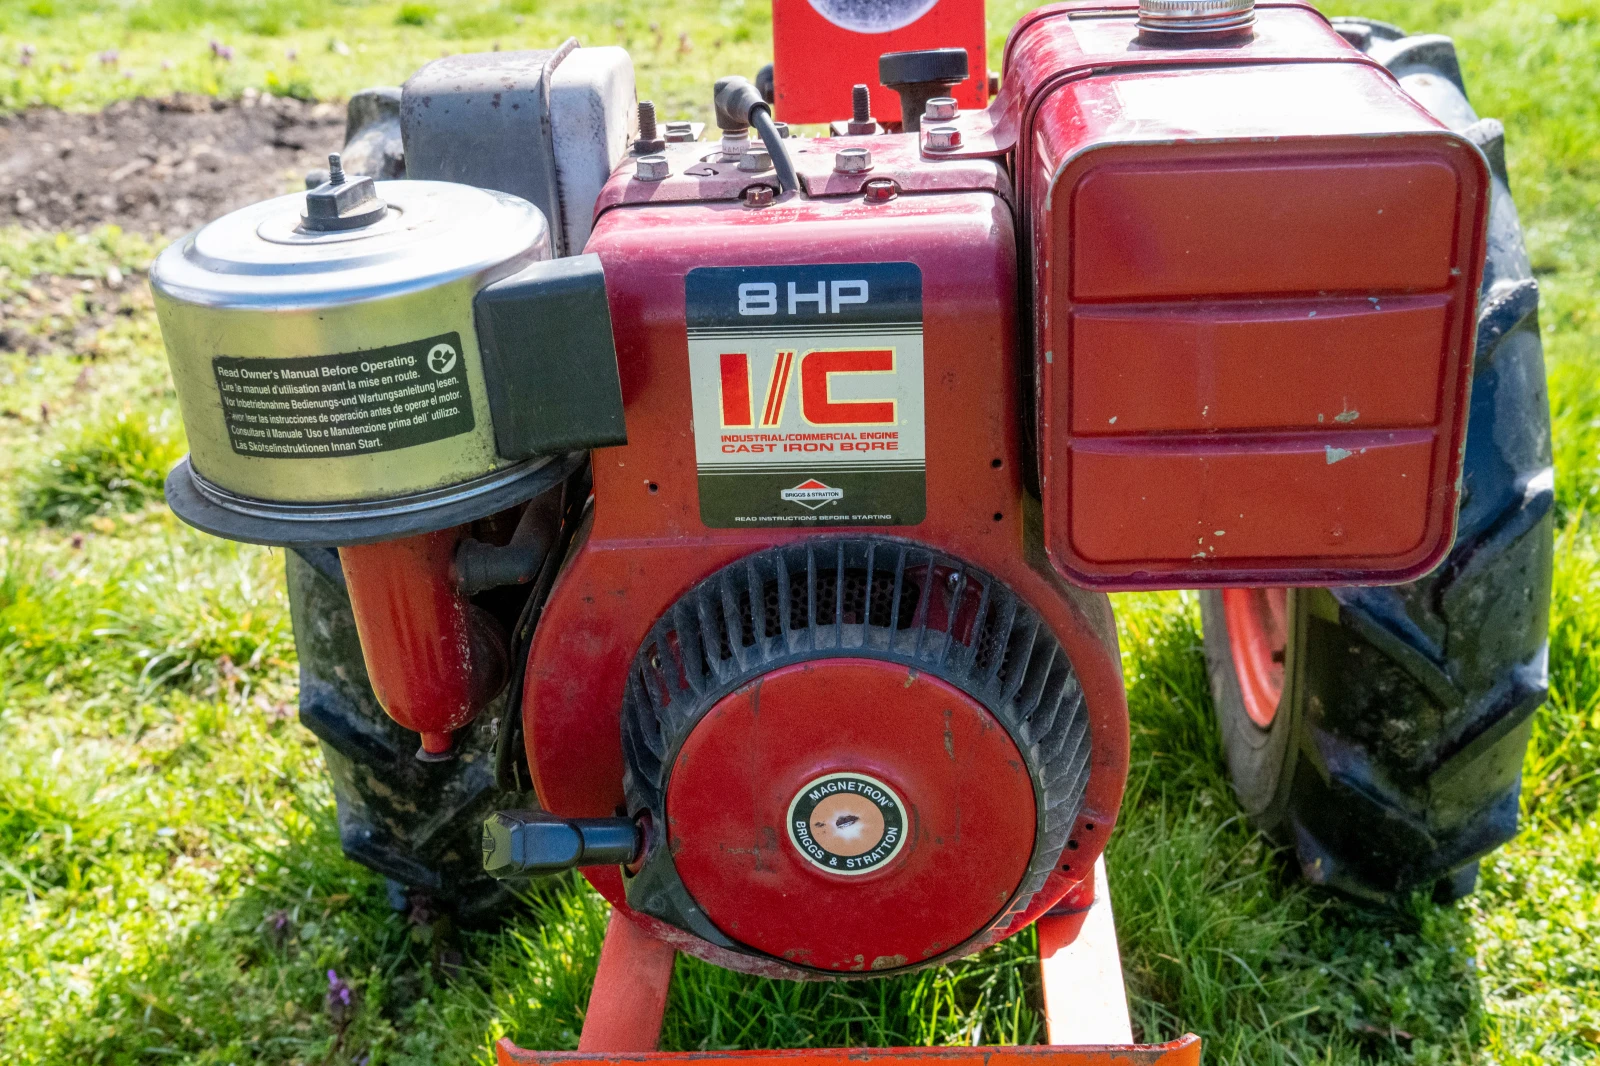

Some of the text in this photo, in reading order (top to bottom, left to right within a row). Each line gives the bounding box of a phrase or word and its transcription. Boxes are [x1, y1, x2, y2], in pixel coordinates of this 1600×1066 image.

[217, 355, 418, 380] Read Owner's Manual Before Operating.
[221, 381, 234, 392] Lire
[243, 385, 271, 394] manuel
[272, 384, 320, 395] d'utilisation
[321, 382, 346, 393] avant
[348, 380, 356, 389] la
[358, 377, 380, 388] mise
[381, 375, 393, 385] en
[395, 370, 420, 382] route.
[224, 377, 459, 410] Vor Inbetriebnahme Bedienungs-und Wartungsanleitung lesen.
[229, 391, 462, 424] avor leer las instrucciones de operación antes de operar el motor.
[231, 425, 265, 438] Consultare
[266, 428, 271, 438] il
[271, 429, 302, 439] Manuale
[324, 429, 329, 437] e
[330, 422, 386, 436] Manutenzione
[388, 419, 411, 431] prima
[431, 406, 460, 420] utilizzo.
[331, 442, 356, 451] Innan
[358, 438, 383, 449] Start.
[720, 431, 898, 443] INDUSTRIAL/COMMERCIAL ENGINE
[721, 442, 899, 454] CAST IRON BORE
[795, 820, 899, 868] BRIGGS & STRATTON
